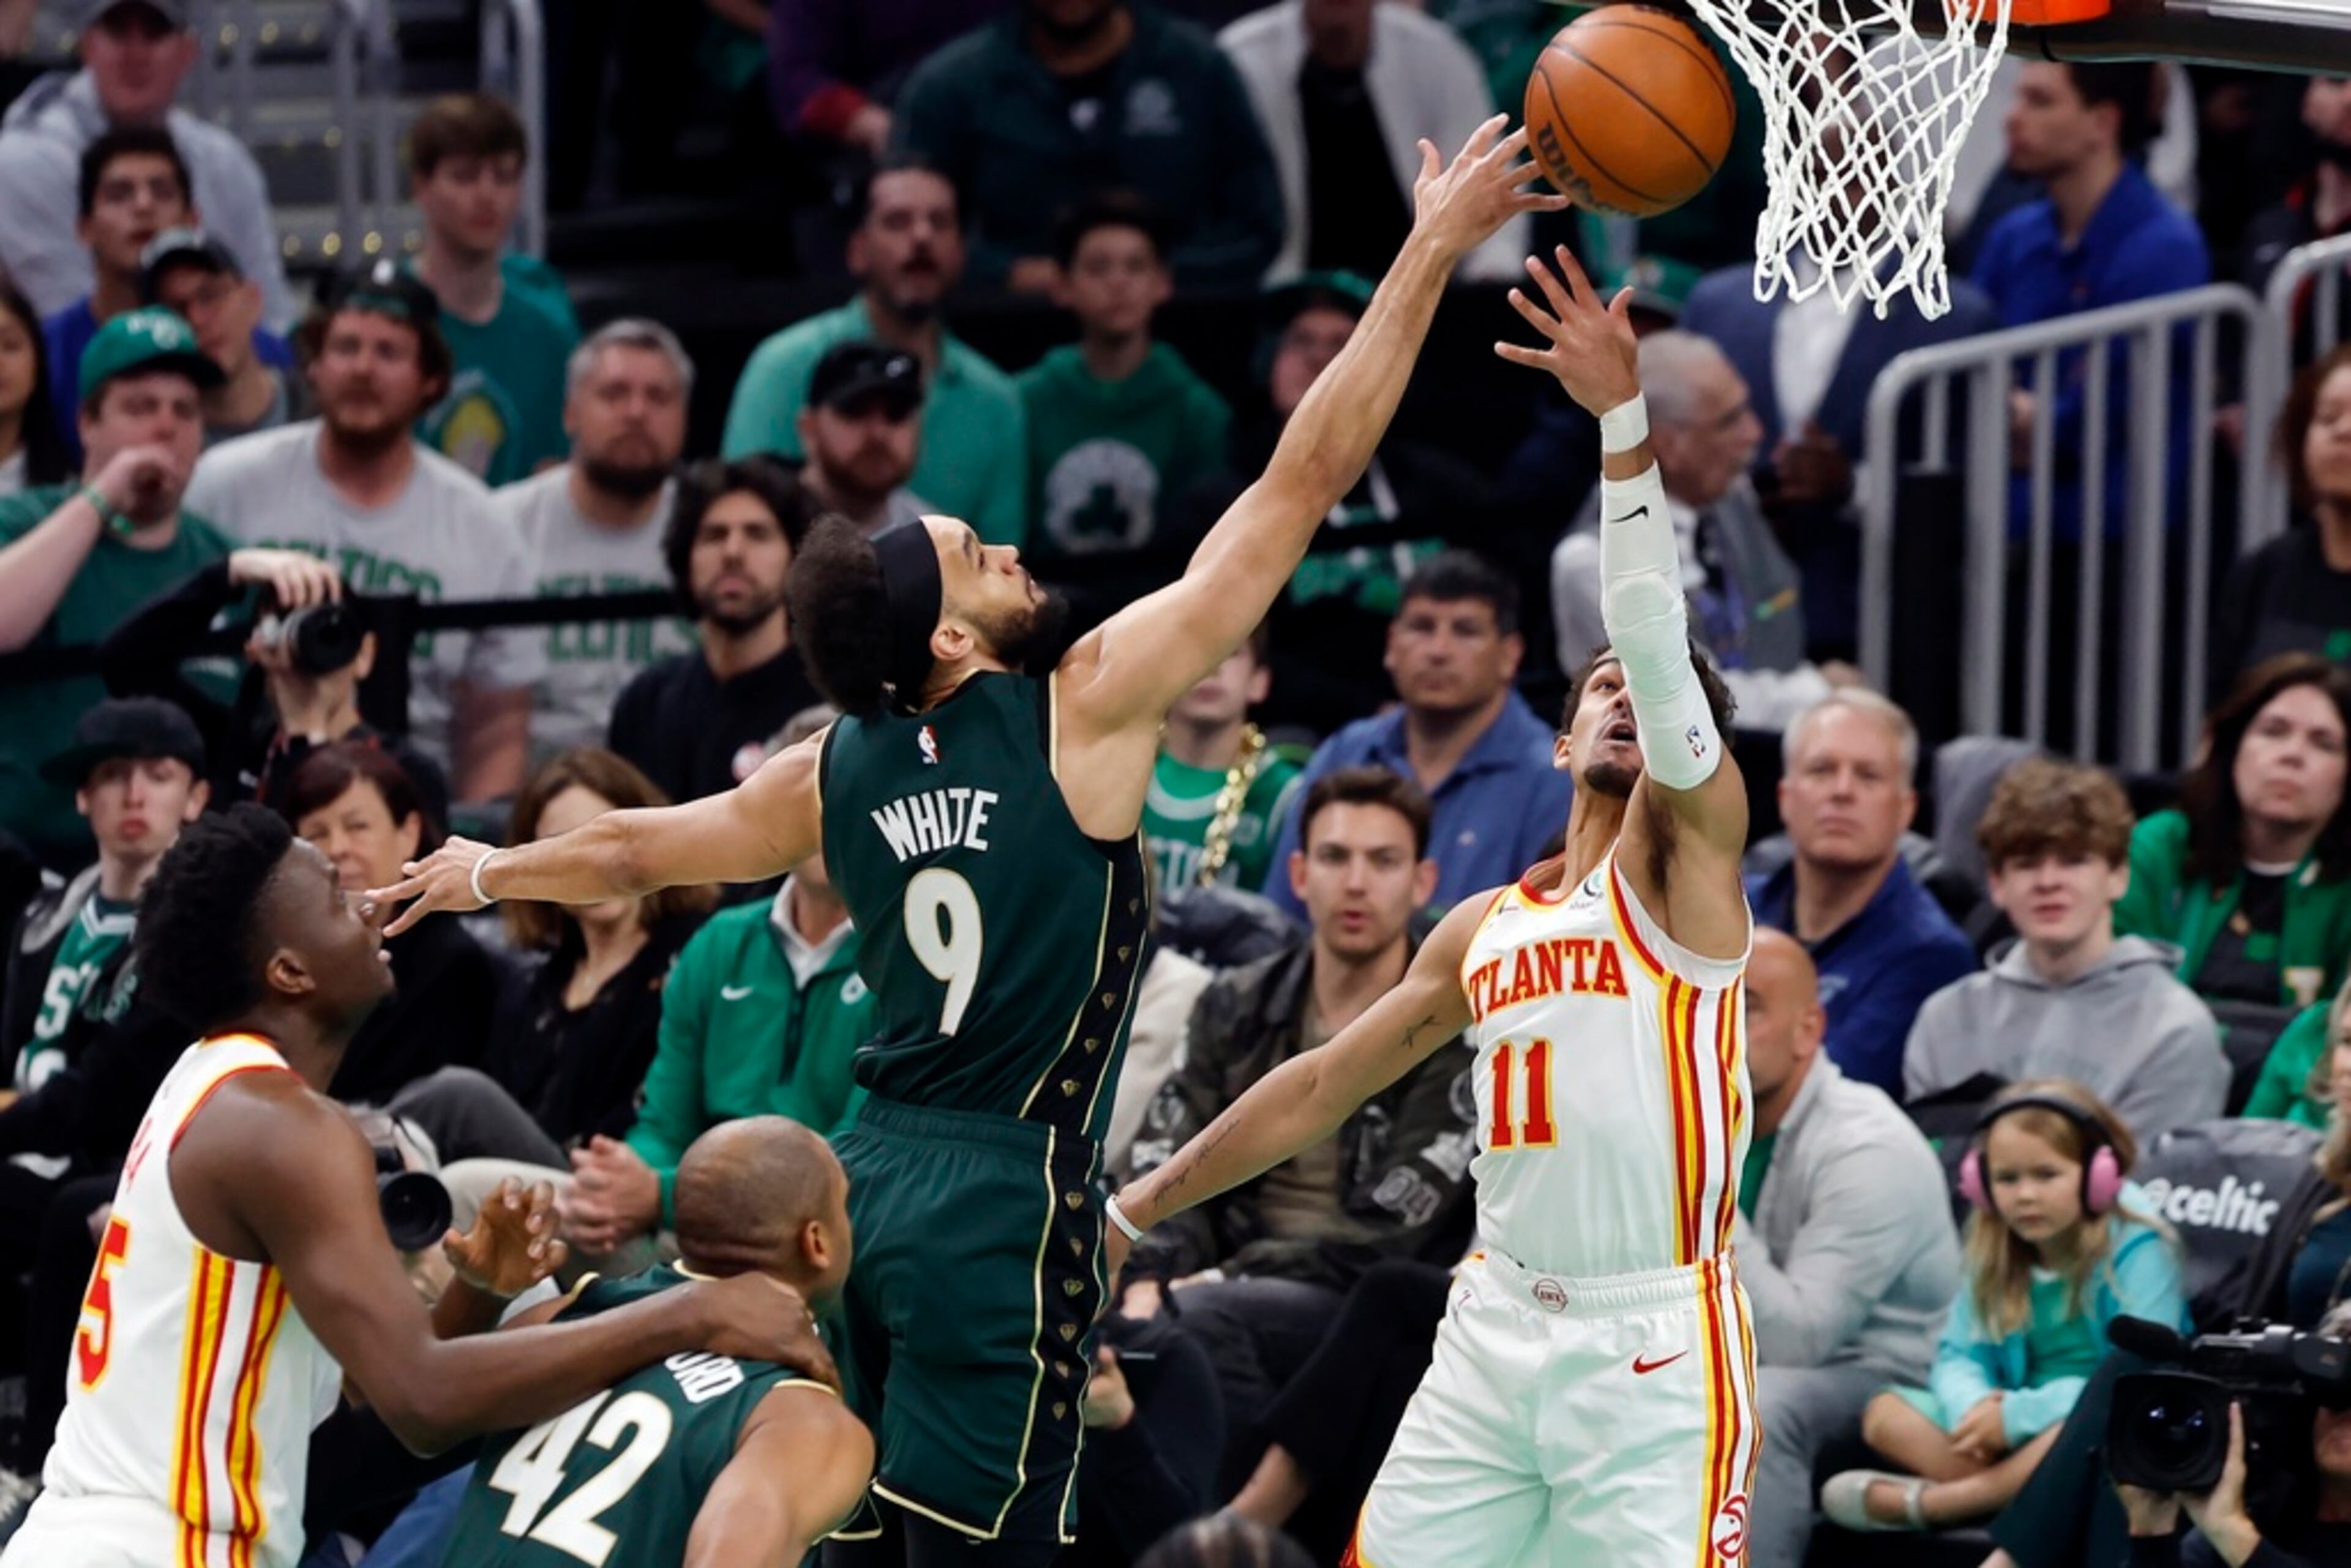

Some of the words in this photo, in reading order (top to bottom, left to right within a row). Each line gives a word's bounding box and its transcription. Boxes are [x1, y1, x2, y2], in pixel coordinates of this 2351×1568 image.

[870, 787, 999, 863] WHITE
[904, 866, 984, 1037] 9
[1488, 1036, 1558, 1152] 11
[487, 1388, 673, 1568] 42
